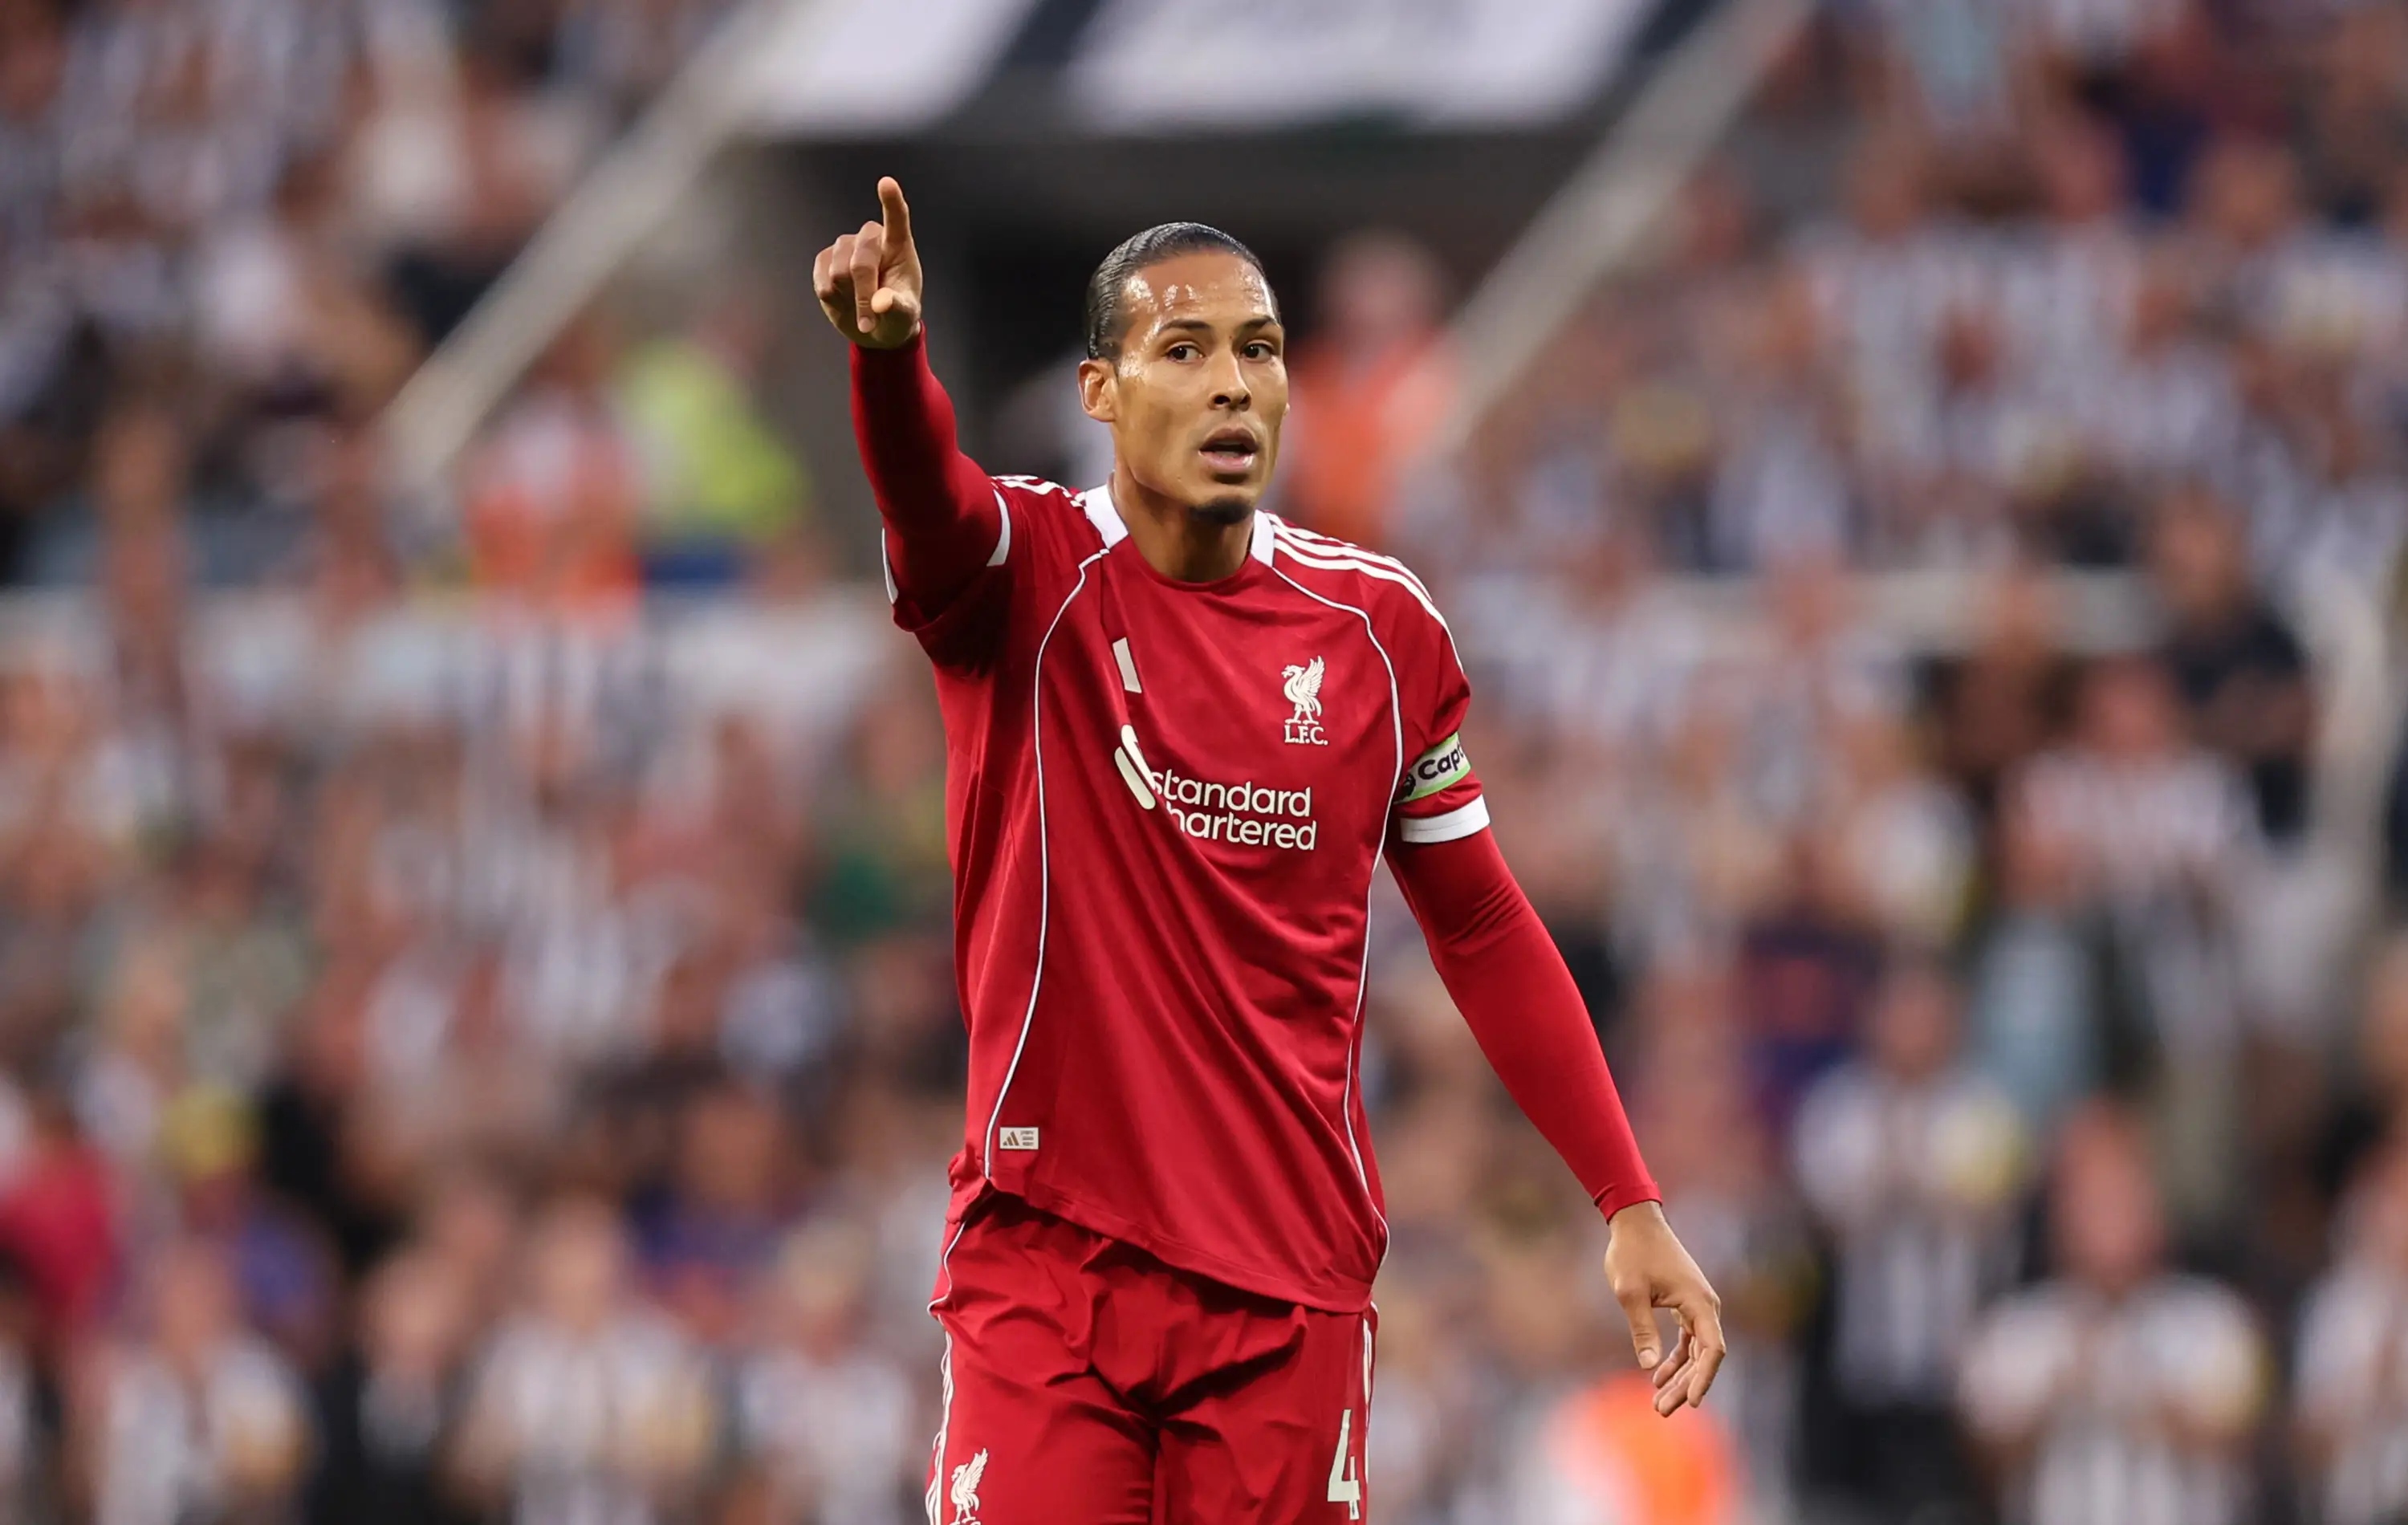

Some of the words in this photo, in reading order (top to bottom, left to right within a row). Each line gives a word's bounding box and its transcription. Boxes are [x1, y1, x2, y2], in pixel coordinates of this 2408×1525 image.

[1284, 724, 1329, 746] L.F.C.
[1150, 768, 1312, 818] standard
[1165, 800, 1318, 852] hartered
[1327, 1409, 1361, 1520] 4
